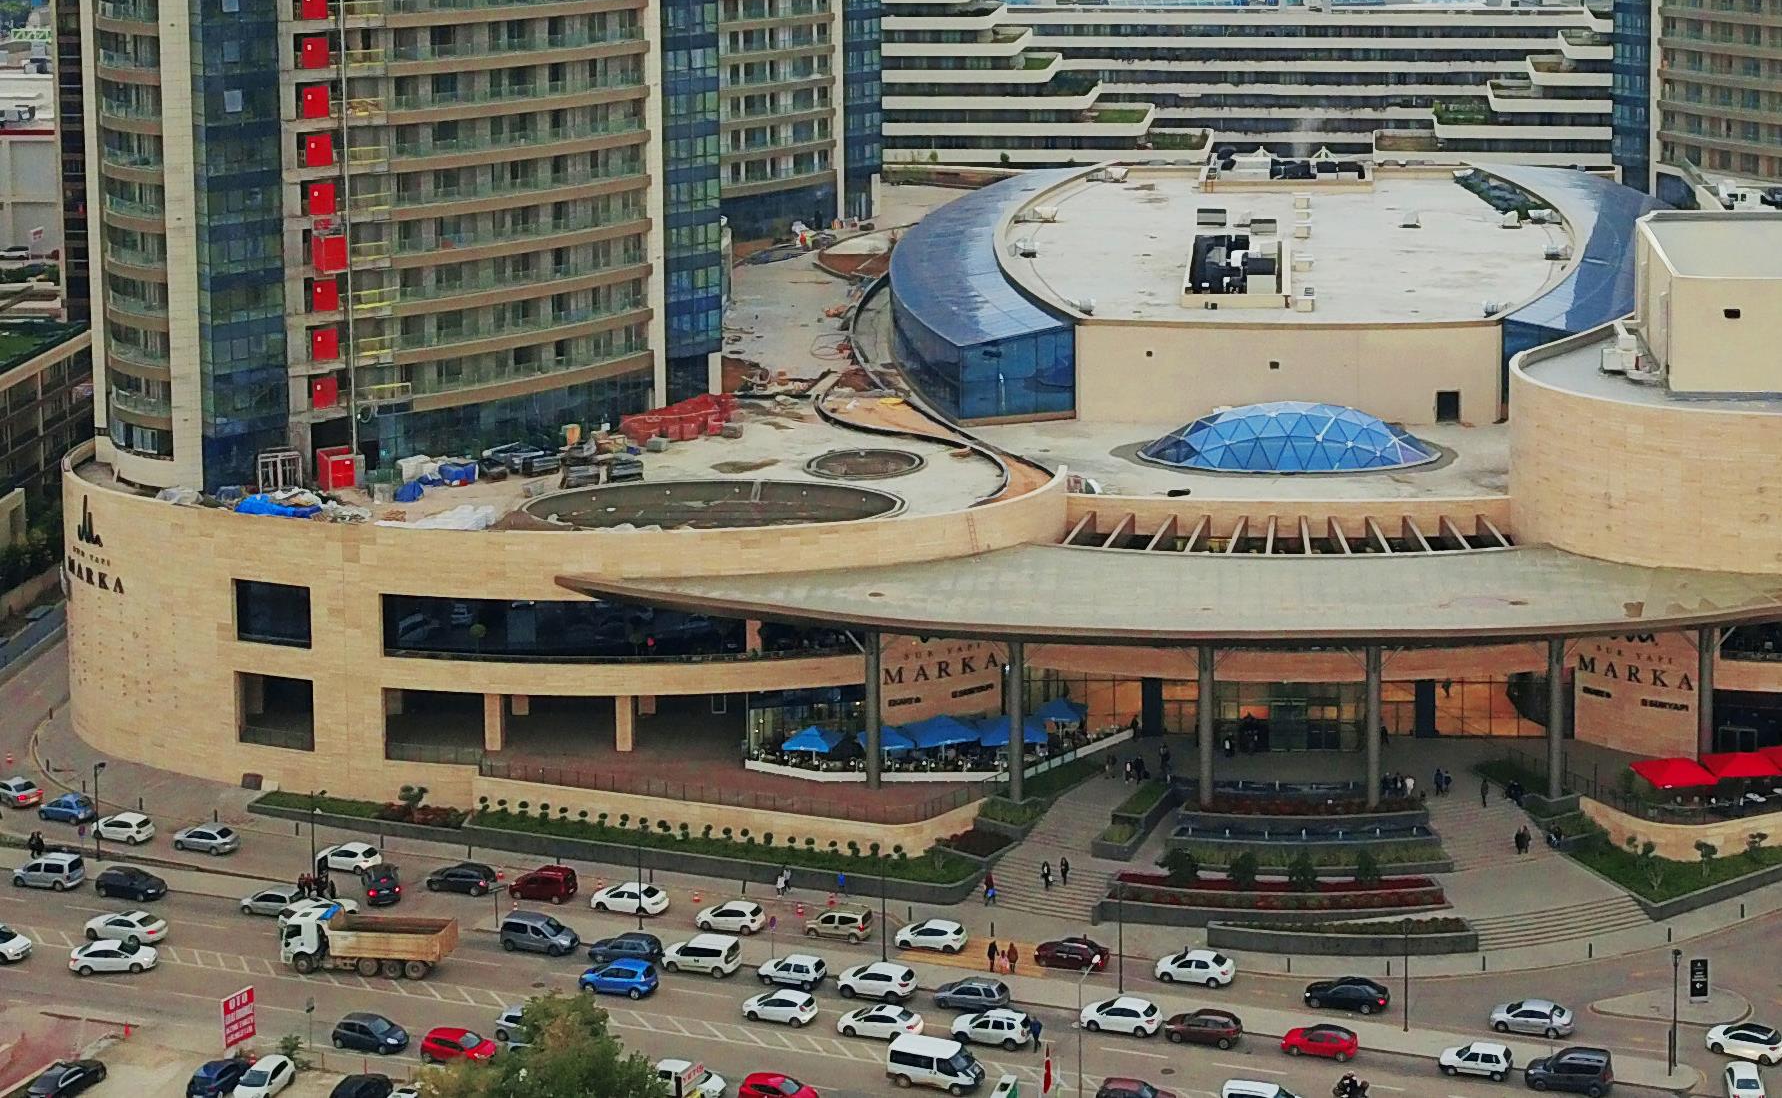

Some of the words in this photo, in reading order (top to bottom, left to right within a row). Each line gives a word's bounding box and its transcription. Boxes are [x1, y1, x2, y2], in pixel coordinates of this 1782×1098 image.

[68, 555, 124, 595] MARKA
[903, 649, 934, 661] SUR
[947, 642, 981, 654] YAPI
[1595, 644, 1623, 657] SUR
[1635, 652, 1673, 665] YAPI
[882, 652, 999, 685] MARKA
[1578, 654, 1694, 691] MARKA
